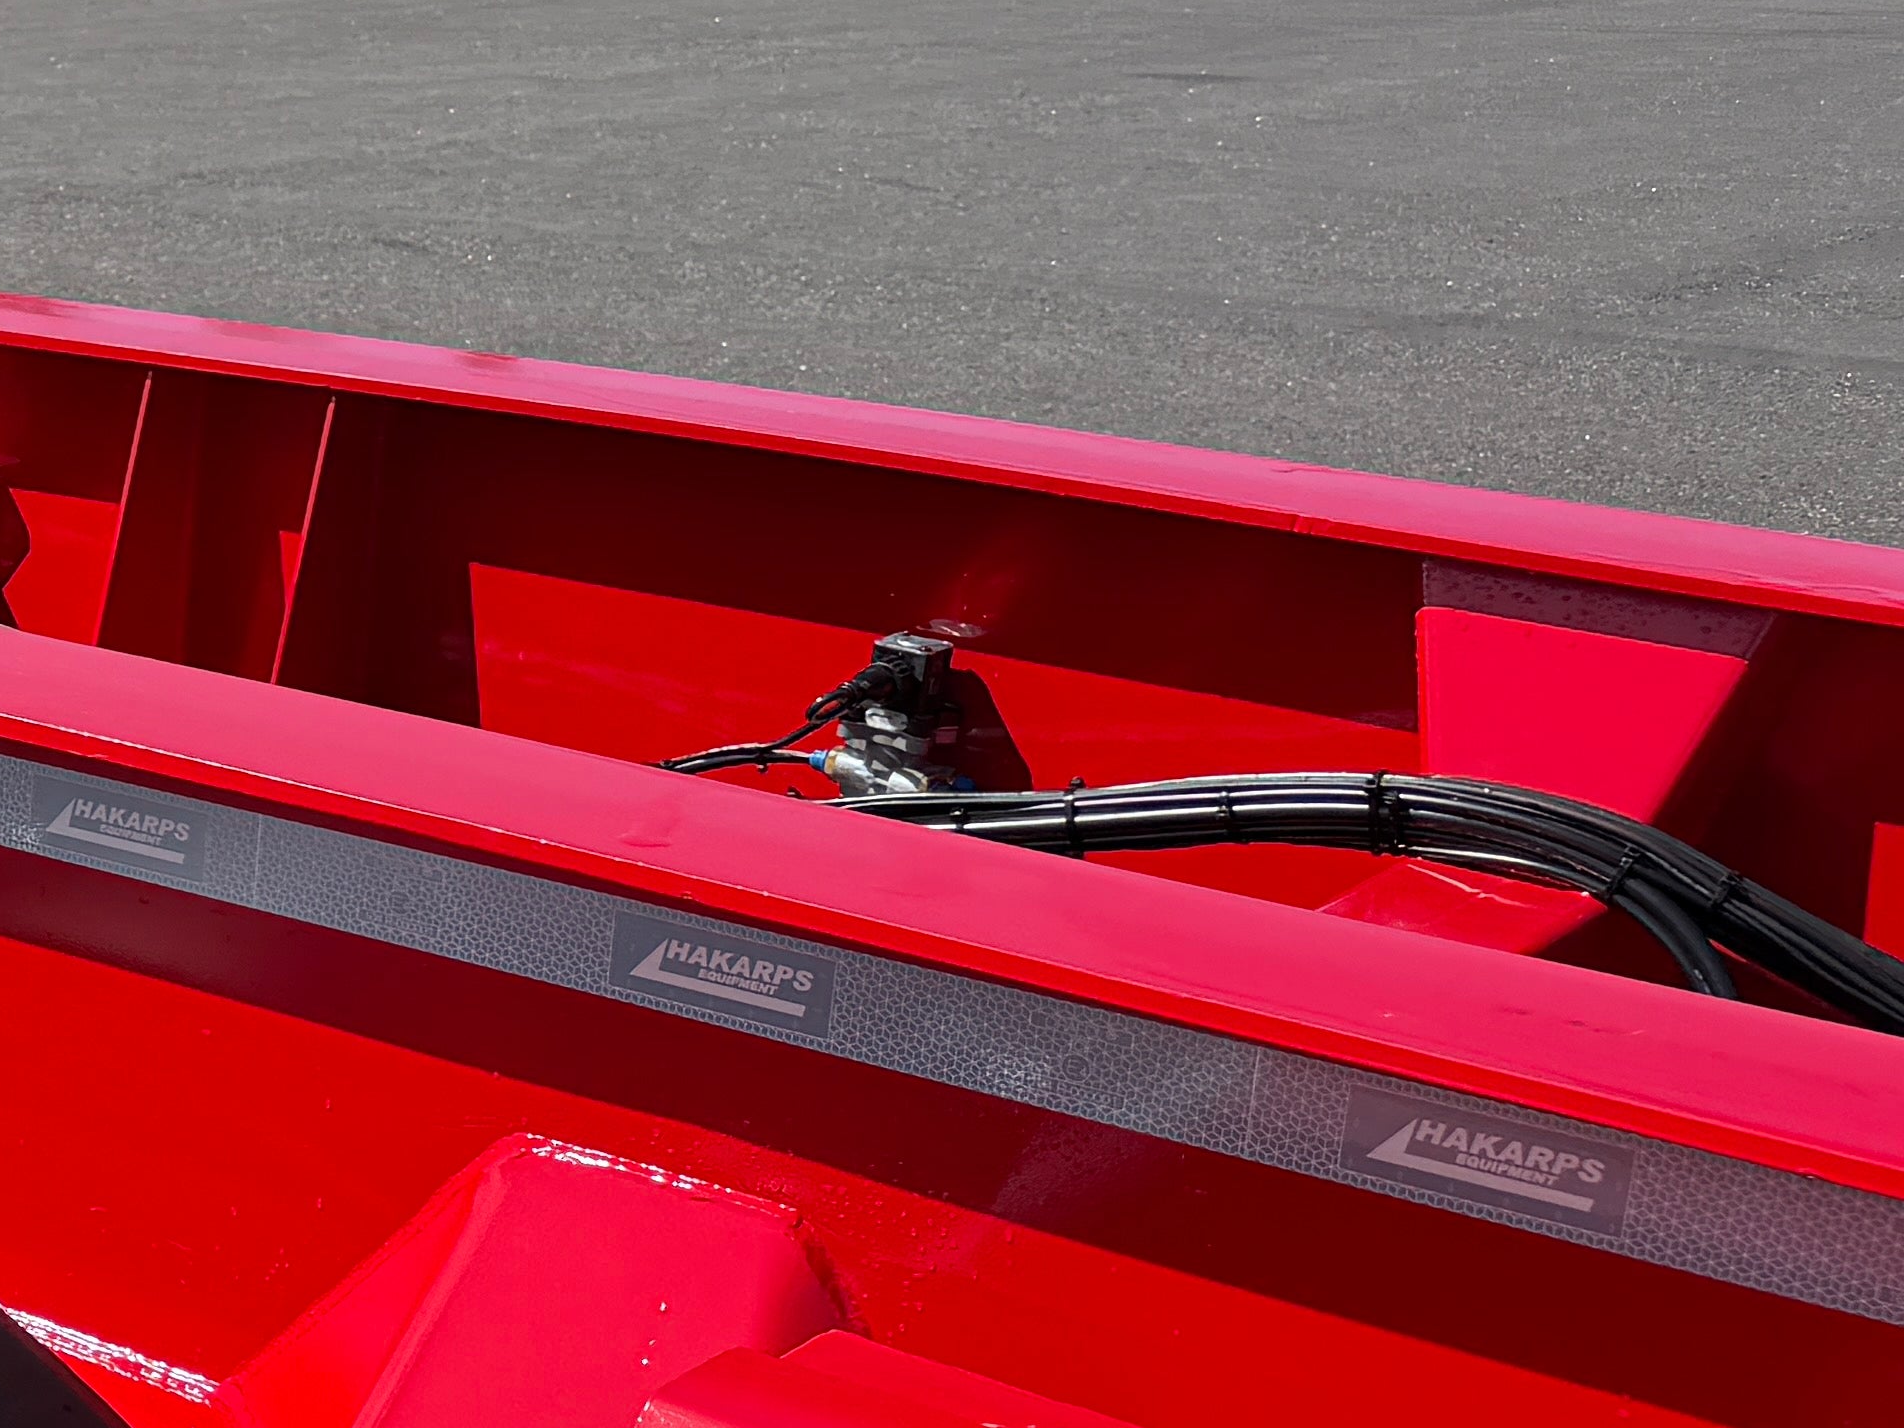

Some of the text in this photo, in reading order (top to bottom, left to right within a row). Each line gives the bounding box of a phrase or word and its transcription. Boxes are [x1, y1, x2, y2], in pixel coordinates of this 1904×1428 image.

[73, 798, 191, 843] HAKARPS
[99, 823, 163, 846] EQUIPMENT
[665, 938, 814, 992] HAKARPS
[697, 968, 777, 996] EQUIPMENT
[1414, 1119, 1606, 1183] HAKARPS
[1455, 1152, 1559, 1185] EQUIPMENT
